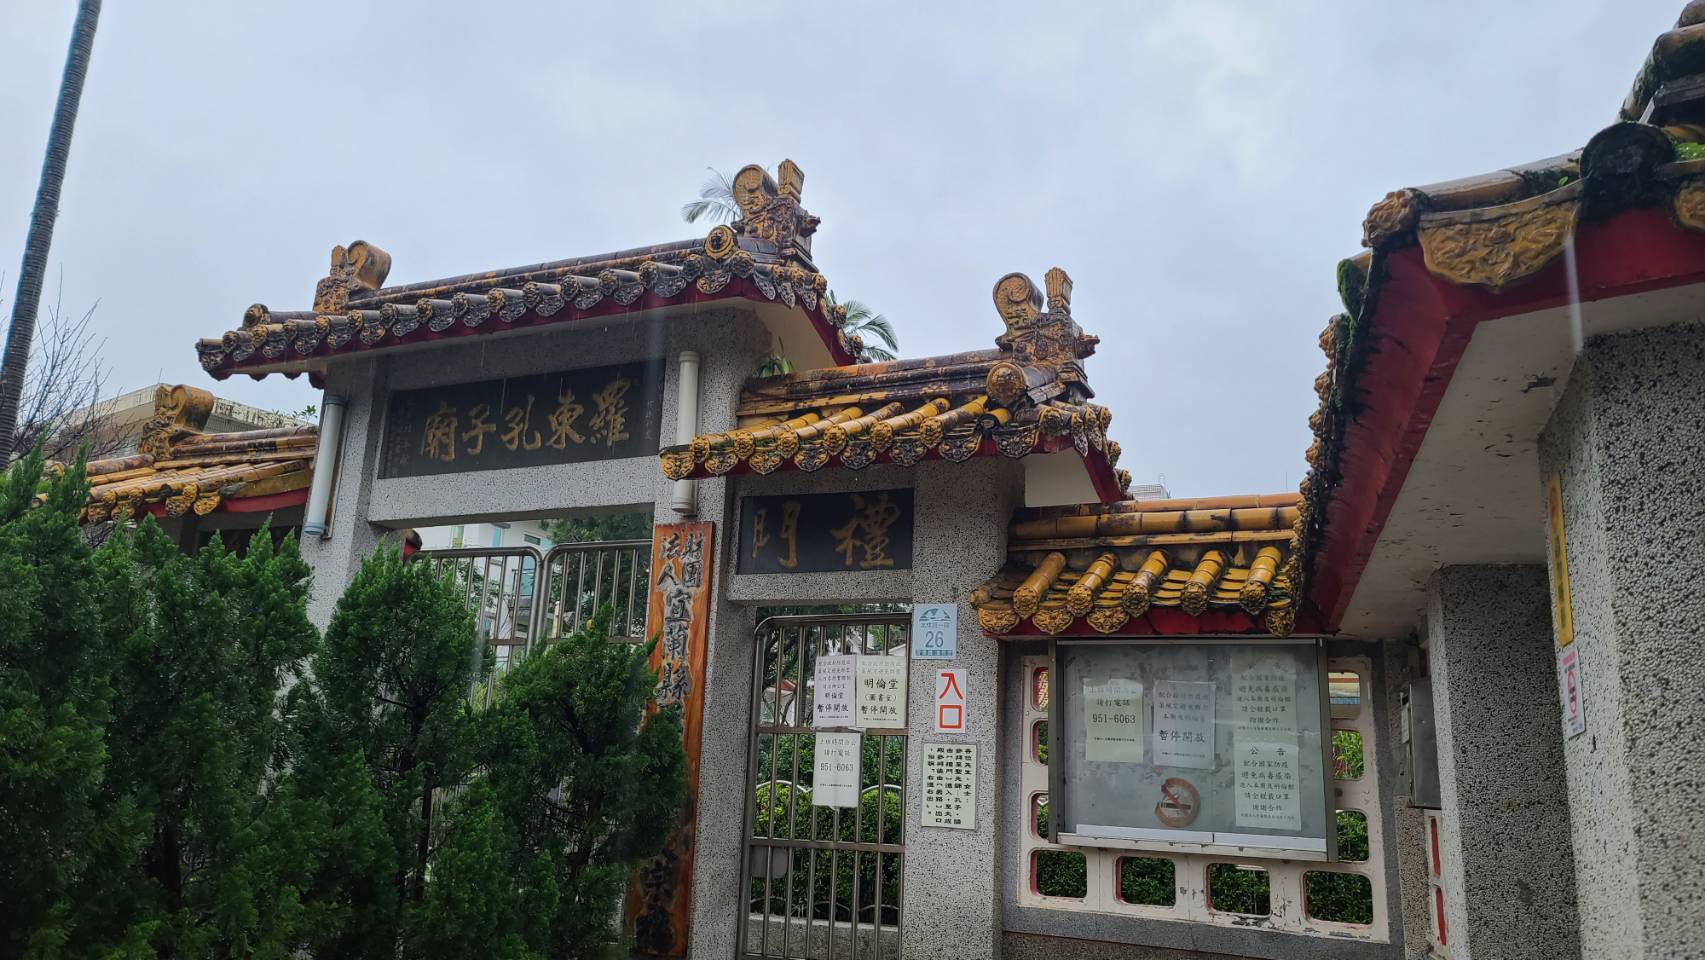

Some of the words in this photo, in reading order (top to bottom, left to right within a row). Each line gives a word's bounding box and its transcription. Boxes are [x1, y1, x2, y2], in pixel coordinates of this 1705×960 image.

[420, 378, 633, 462] 羅東孔子廟
[752, 494, 901, 570] 禮門
[925, 631, 944, 648] 26
[864, 678, 899, 690] 明倫堂
[817, 703, 849, 713] 暫停開放
[939, 672, 964, 730] 入口
[1092, 713, 1136, 724] 951-6063
[1159, 729, 1206, 743] 暫停開放
[820, 763, 854, 772] 951-6063
